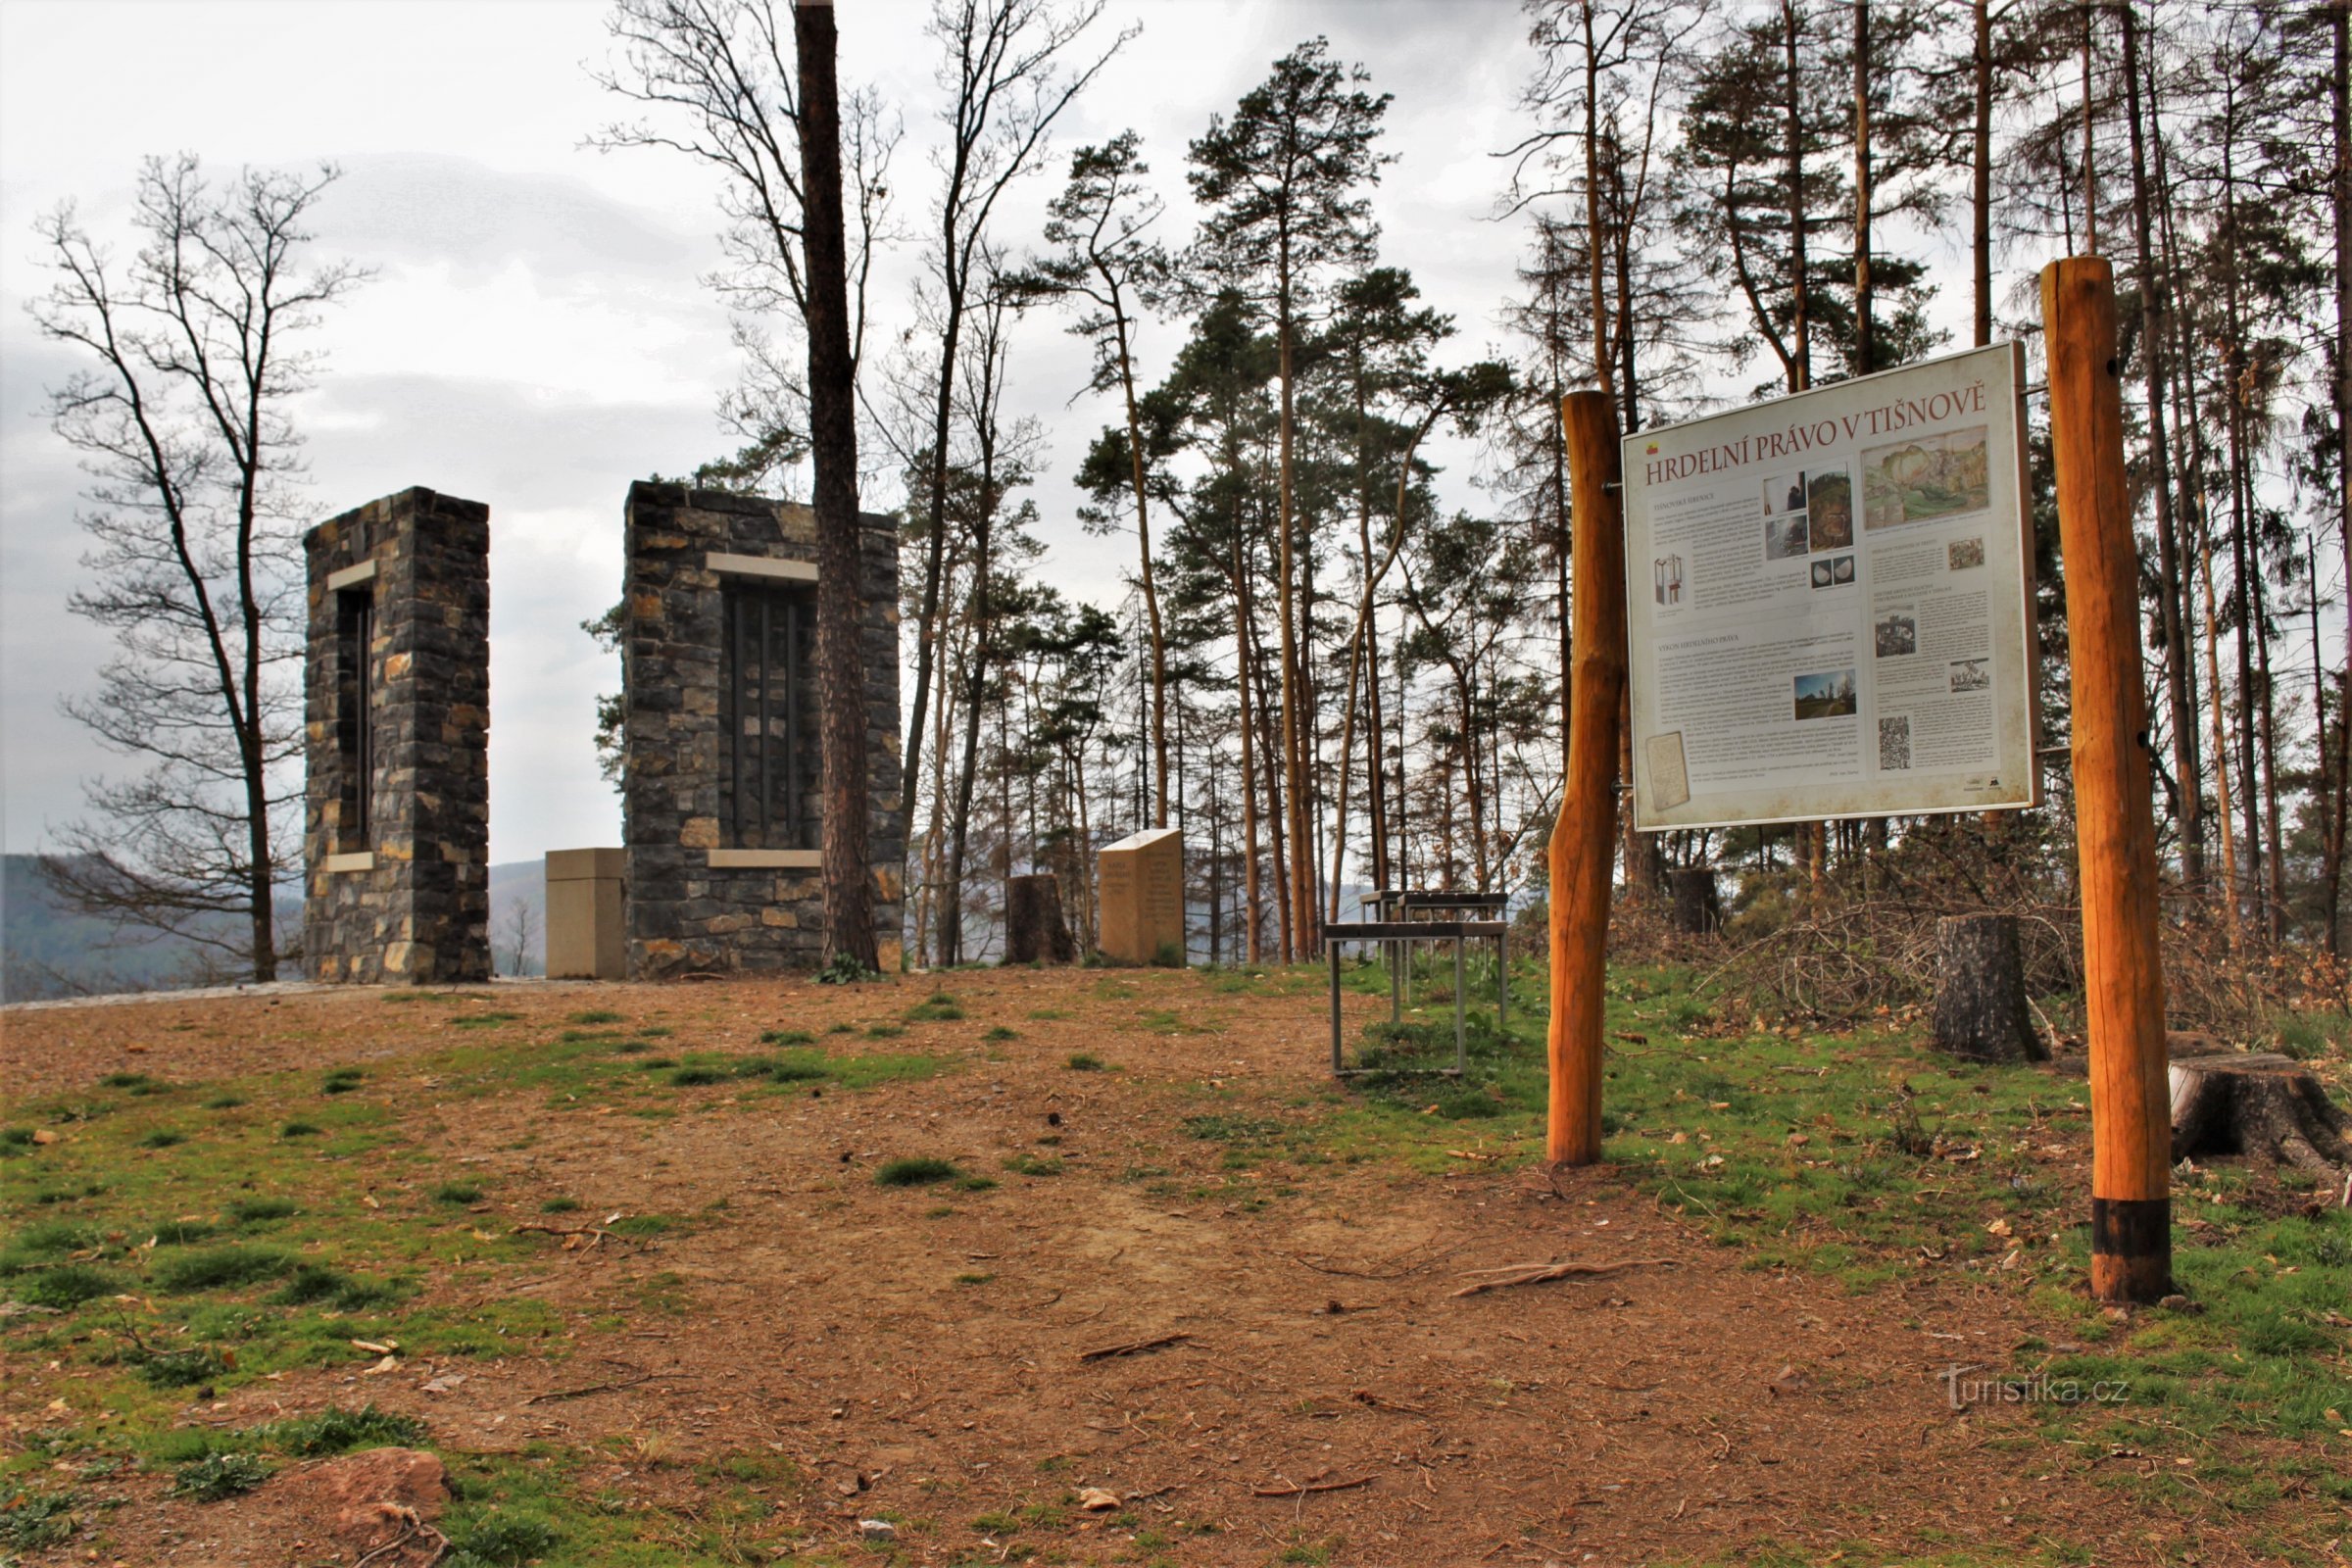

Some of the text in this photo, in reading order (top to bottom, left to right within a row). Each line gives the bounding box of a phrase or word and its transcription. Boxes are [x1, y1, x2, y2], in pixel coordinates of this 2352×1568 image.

[1645, 378, 1986, 486] HRDELNÍ PRÁVO V TIŠNOVĚ
